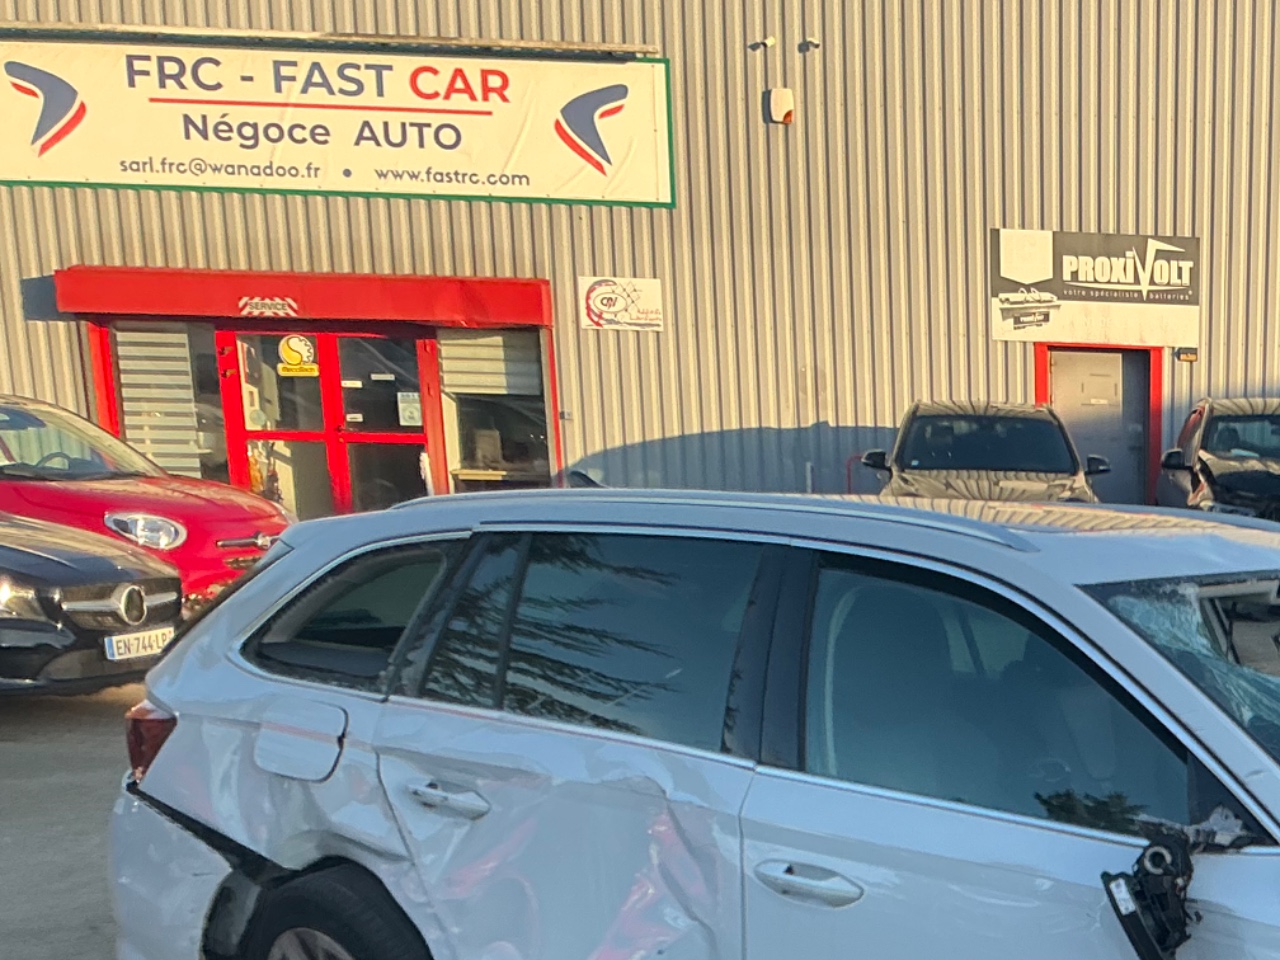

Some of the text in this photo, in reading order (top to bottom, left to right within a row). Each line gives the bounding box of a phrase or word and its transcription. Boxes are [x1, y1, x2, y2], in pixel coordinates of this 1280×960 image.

[125, 54, 224, 91] FRC
[272, 59, 393, 98] FAST
[409, 66, 511, 103] CAR
[182, 112, 462, 150] Négoce AUTO
[119, 156, 530, 186] sarl.frc@wanadoo.fr www.fastrc.com
[248, 301, 288, 311] SERVICE
[1063, 288, 1190, 301] votre spécialiste batteries
